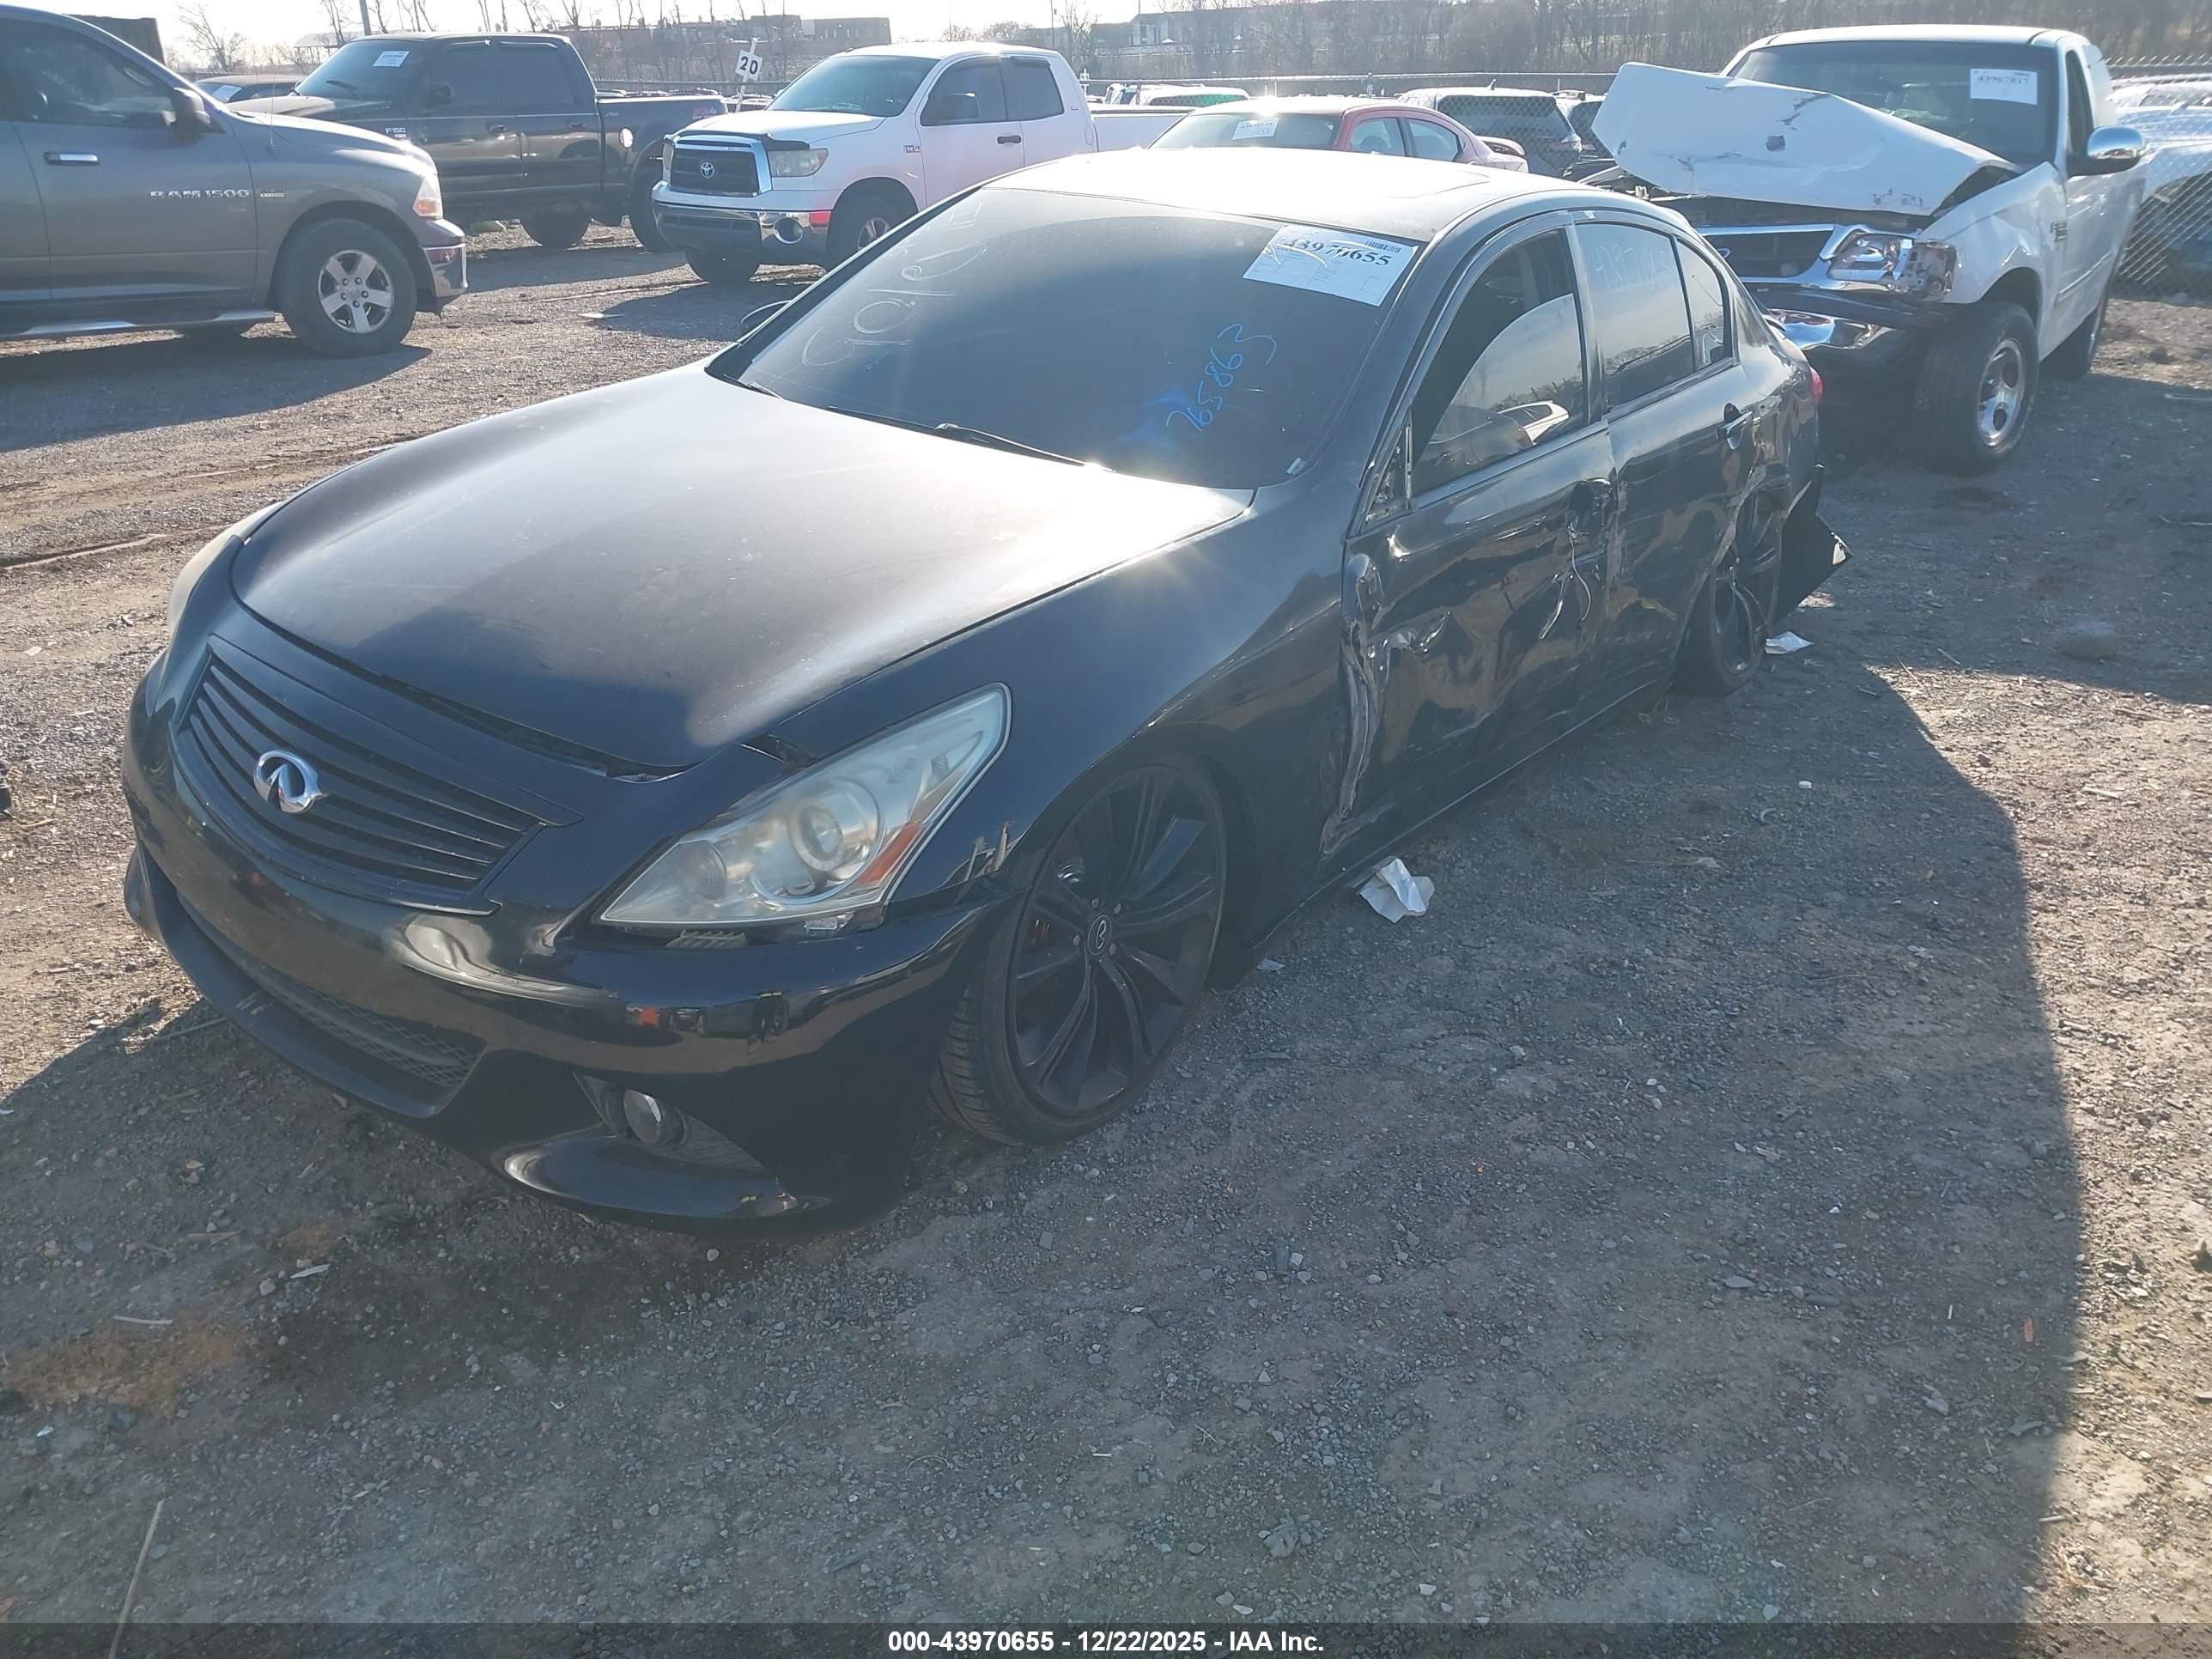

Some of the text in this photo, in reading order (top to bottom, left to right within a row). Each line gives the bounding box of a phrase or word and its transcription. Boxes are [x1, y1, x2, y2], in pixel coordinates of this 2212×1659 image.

[739, 56, 758, 75] 20
[150, 191, 201, 199] RAM
[204, 189, 250, 198] 1500
[1285, 239, 1393, 266] 43970655
